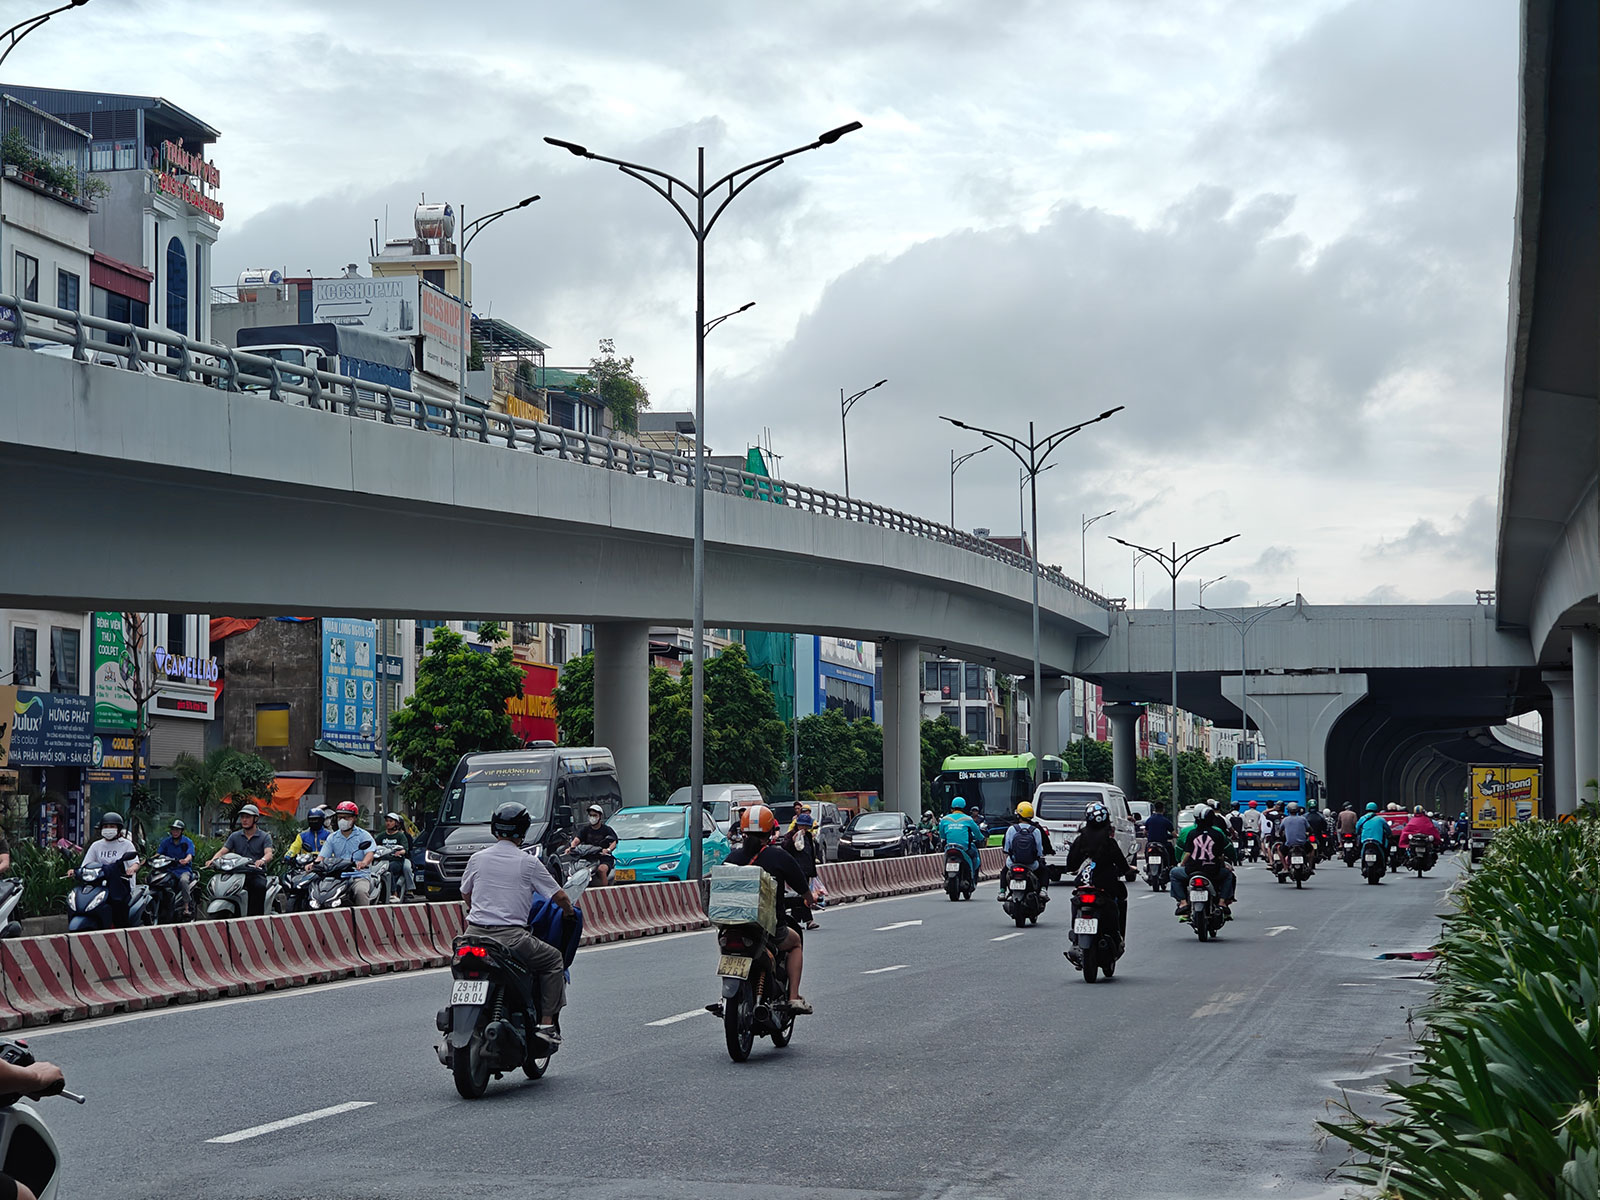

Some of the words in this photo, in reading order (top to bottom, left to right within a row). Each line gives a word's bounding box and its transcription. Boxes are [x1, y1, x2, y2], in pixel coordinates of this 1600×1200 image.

[317, 280, 404, 301] KCCSHOP.VN
[422, 288, 471, 335] KCCSHOP.N
[98, 644, 119, 656] COOLPET
[164, 653, 219, 682] CAMELLIA6
[48, 707, 70, 722] HƯNG
[71, 707, 91, 723] PHÁT
[22, 748, 39, 761] PHÂN
[40, 747, 53, 762] PHỐI
[54, 750, 66, 762] SƠN
[100, 850, 118, 858] HER
[457, 982, 483, 992] 29-H1
[452, 992, 483, 1003] 848.04
